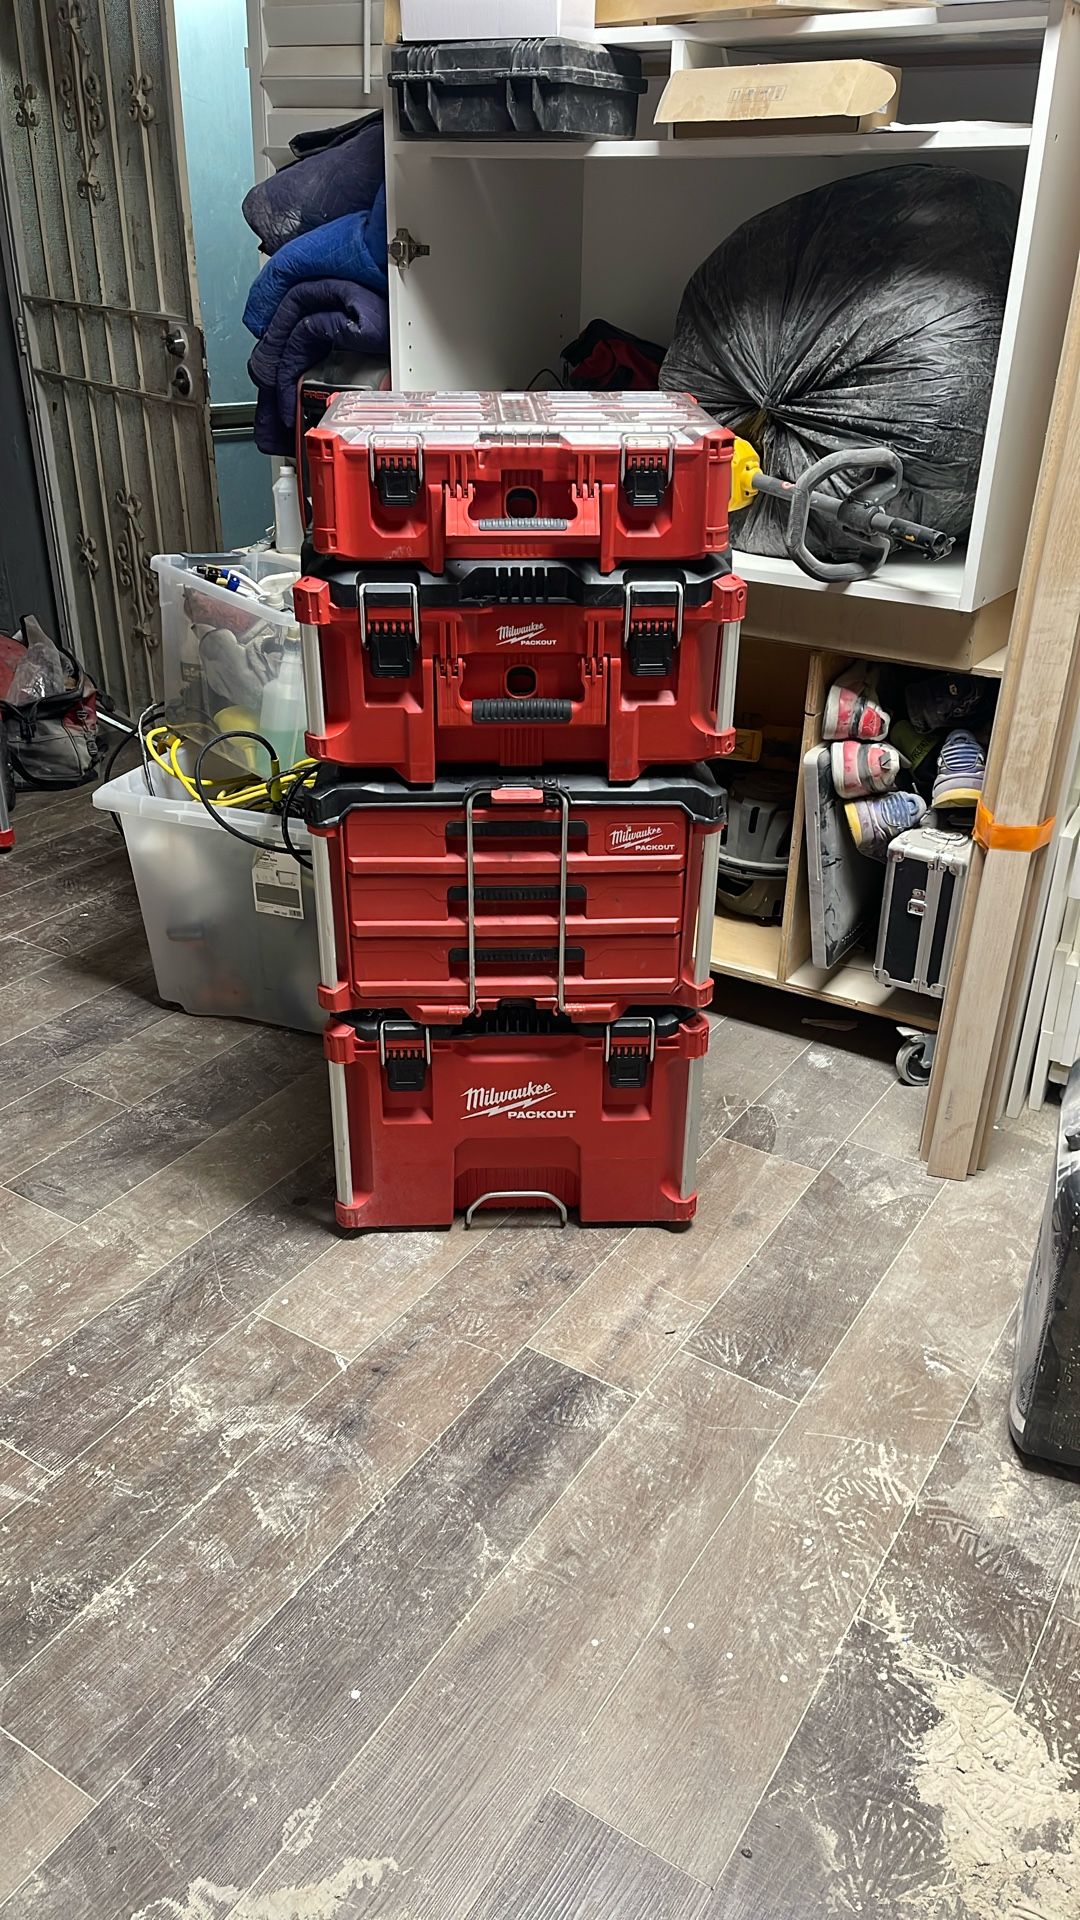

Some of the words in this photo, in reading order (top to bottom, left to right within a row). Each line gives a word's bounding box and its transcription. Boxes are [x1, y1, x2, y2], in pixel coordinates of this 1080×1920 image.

[496, 622, 545, 640] Milwaukee
[609, 826, 662, 845] Milwaukee
[460, 1081, 553, 1111] Milwaukee
[507, 1110, 576, 1119] PACKOUT
